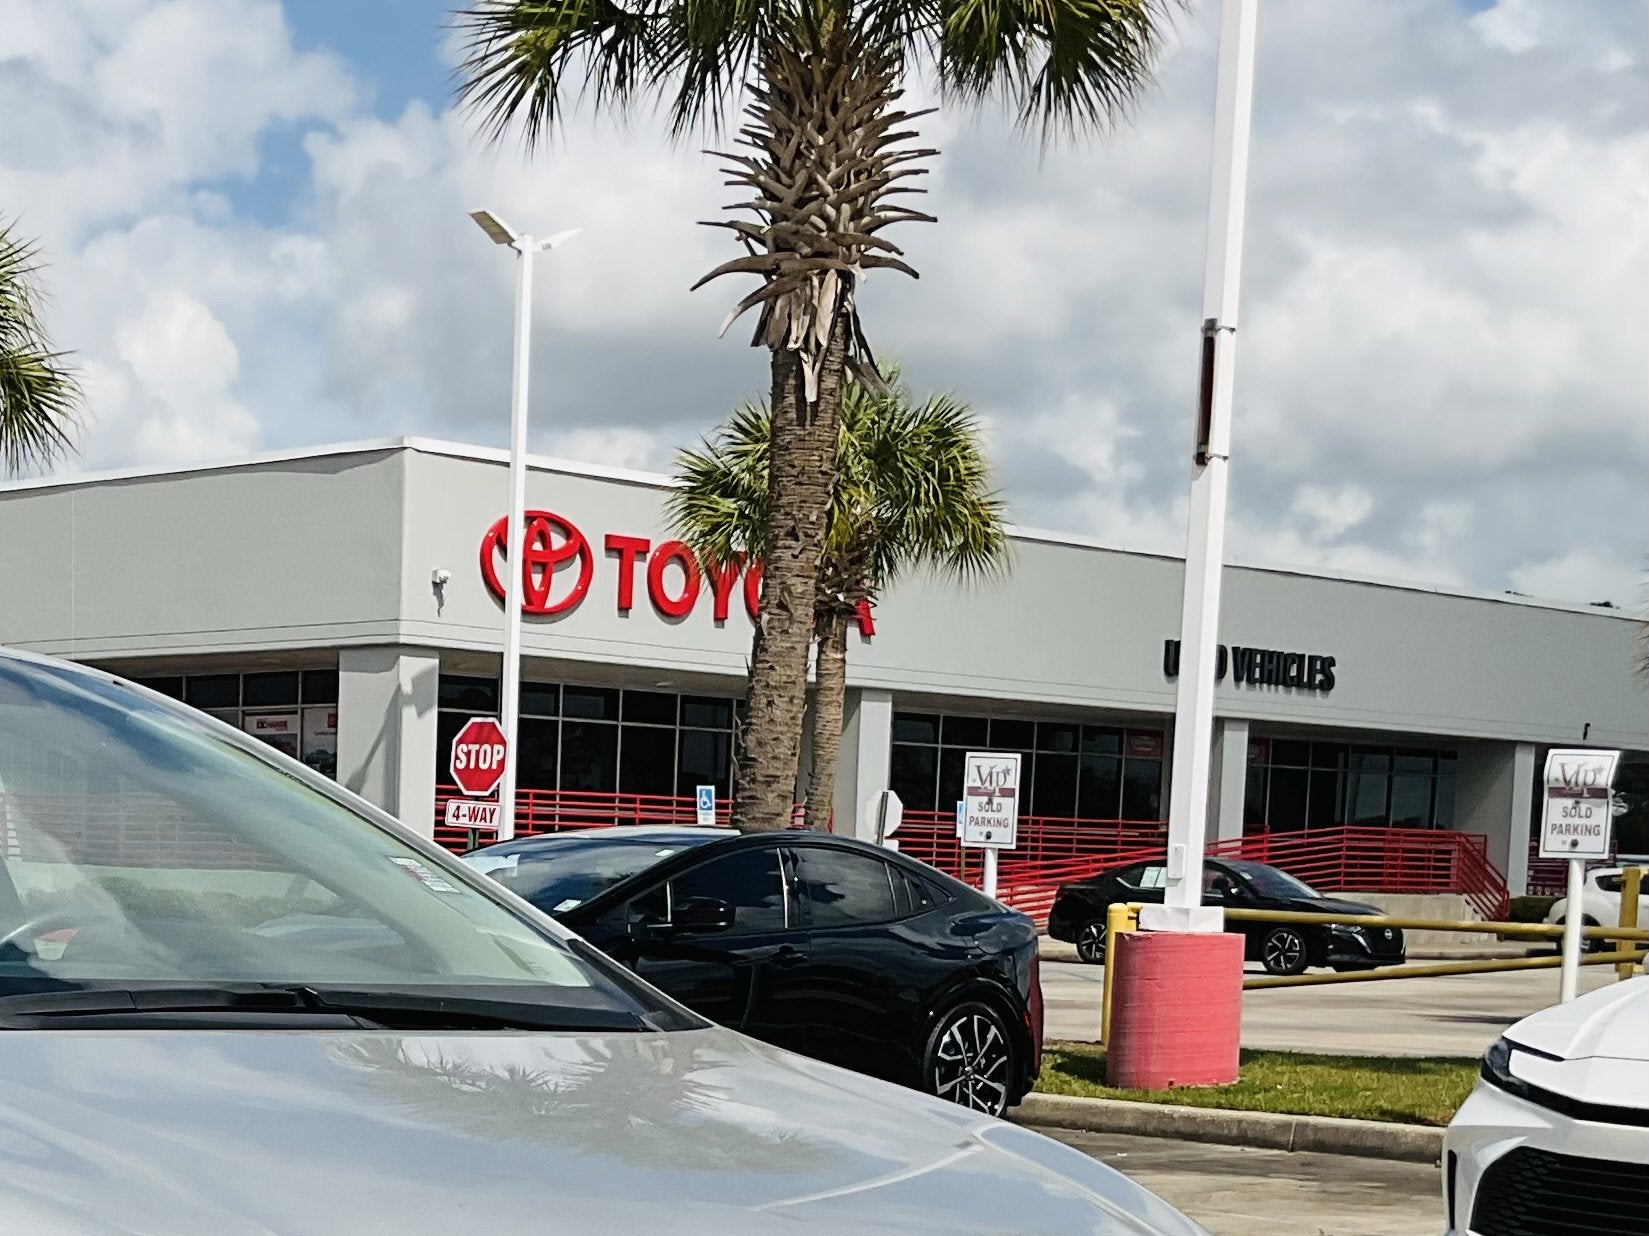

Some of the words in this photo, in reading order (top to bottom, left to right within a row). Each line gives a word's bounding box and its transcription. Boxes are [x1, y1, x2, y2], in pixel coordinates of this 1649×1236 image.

[604, 533, 875, 636] TOY
[1164, 639, 1228, 680] UD
[1231, 646, 1336, 691] VEHICLES
[455, 743, 505, 770] STOP
[452, 805, 496, 824] 4-WAY
[977, 802, 1002, 813] SOLD
[1562, 806, 1592, 819] SOLD
[969, 816, 1009, 828] PARKING
[1551, 823, 1601, 836] PARKING
